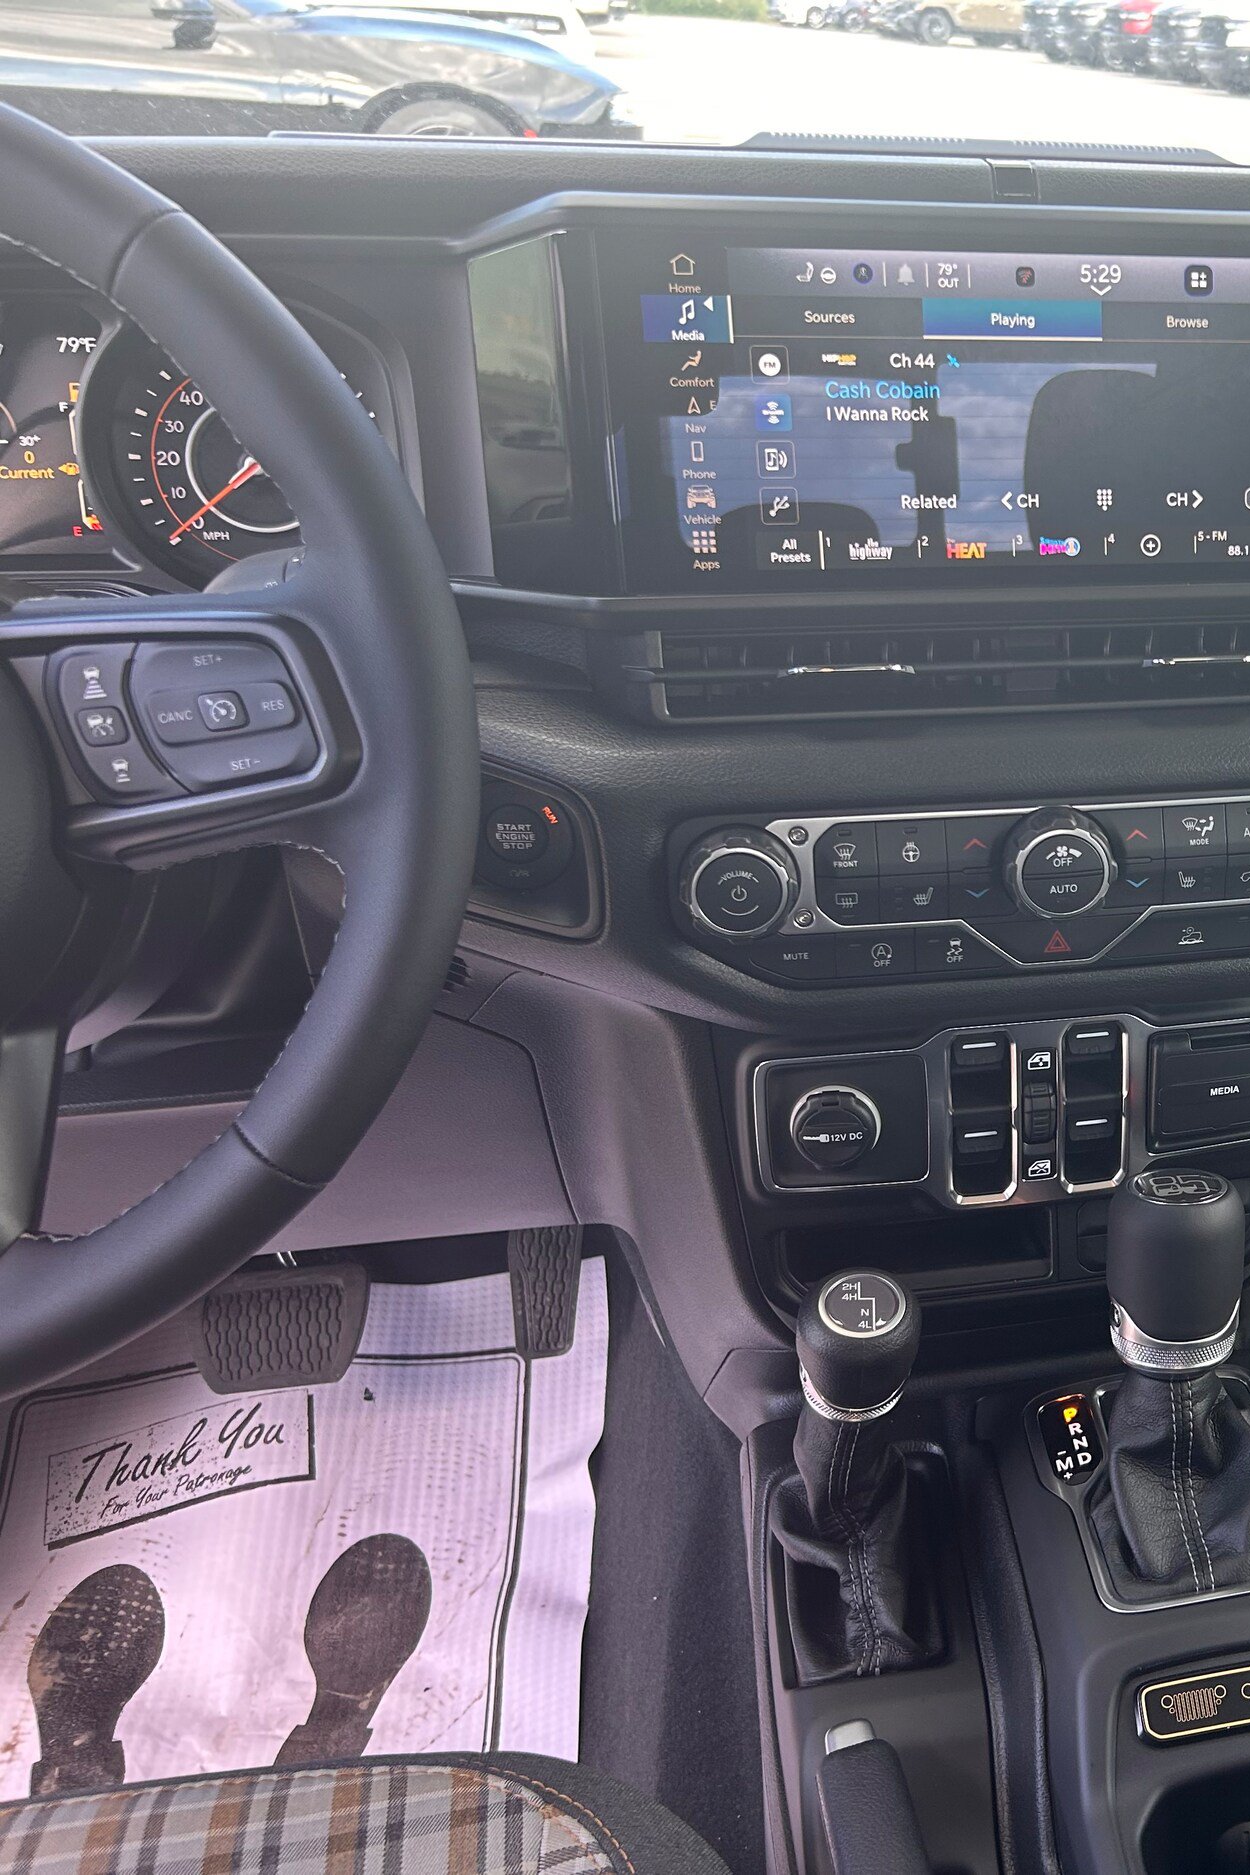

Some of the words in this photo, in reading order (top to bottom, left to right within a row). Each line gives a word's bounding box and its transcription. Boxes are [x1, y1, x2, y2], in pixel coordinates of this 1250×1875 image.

[1079, 264, 1122, 284] 5:29
[668, 283, 701, 294] Home
[937, 278, 960, 289] OUT
[804, 311, 855, 324] Sources
[990, 313, 1035, 328] Playing
[1166, 316, 1209, 329] Browse
[671, 330, 705, 342] Media
[56, 337, 97, 353] 79°F
[889, 353, 912, 368] Ch
[914, 354, 935, 368] 44
[669, 377, 715, 388] Comfort
[825, 382, 871, 400] Cash
[876, 382, 940, 400] Cobain
[179, 391, 204, 406] 40
[58, 401, 69, 413] F
[826, 407, 831, 421] I
[834, 407, 888, 422] Wanna
[892, 407, 929, 422] Rock
[164, 421, 185, 433] 30
[685, 423, 707, 434] Nav
[24, 450, 36, 464] 0
[156, 451, 181, 466] 20
[0, 465, 55, 479] Current
[682, 469, 717, 480] Phone
[171, 486, 187, 499] 10
[901, 494, 958, 510] Related
[1016, 493, 1039, 508] CH
[1166, 492, 1189, 507] CH
[683, 514, 722, 525] Vehicle
[72, 526, 83, 537] E
[202, 531, 230, 541] MPH
[1212, 530, 1228, 542] FM
[781, 539, 798, 550] All
[921, 535, 929, 547] 2
[1016, 534, 1023, 545] 3
[1107, 533, 1116, 544] 4
[849, 542, 893, 560] highway
[946, 542, 987, 559] HEAT
[1227, 545, 1249, 556] 88.1
[770, 552, 812, 563] Presets
[693, 559, 721, 572] Apps
[262, 700, 285, 711] RES
[157, 710, 193, 724] CANC
[542, 806, 558, 825] RUN
[496, 823, 532, 832] START
[495, 832, 536, 841] ENGINE
[1189, 837, 1210, 846] MODE
[502, 842, 533, 850] STOP
[833, 860, 858, 869] FRONT
[1053, 857, 1073, 868] OFF
[720, 870, 754, 882] VOLUME
[1050, 884, 1078, 894] AUTO
[783, 952, 809, 961] MUTE
[946, 954, 964, 963] OFF
[873, 958, 891, 968] OFF
[1210, 1083, 1240, 1097] MEDIA
[830, 1133, 847, 1142] 12V
[850, 1132, 864, 1141] DC
[842, 1282, 858, 1291] 2H
[860, 1308, 870, 1316] N
[858, 1320, 872, 1329] 4L
[1063, 1407, 1078, 1423] P
[1068, 1422, 1083, 1436] R
[1072, 1436, 1089, 1451] N
[75, 1417, 208, 1504] Thank
[218, 1402, 285, 1459] You
[1055, 1456, 1074, 1472] M
[1077, 1452, 1092, 1466] D
[100, 1495, 129, 1519] For
[135, 1484, 168, 1509] Your
[173, 1464, 252, 1496] Patronage
